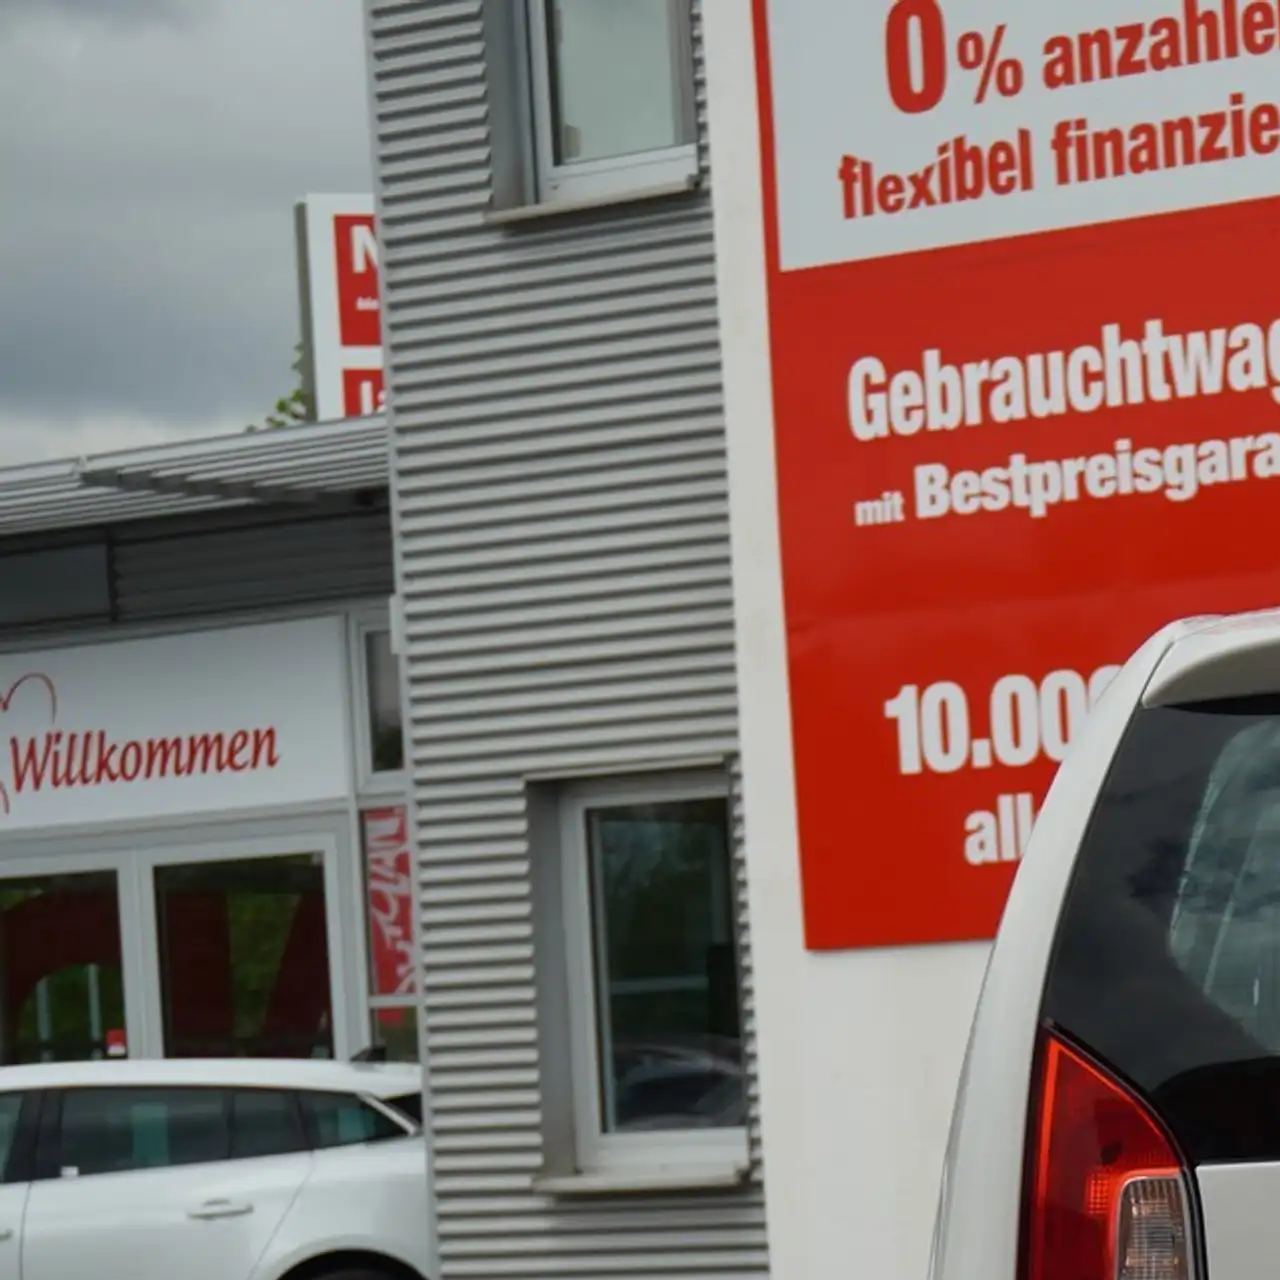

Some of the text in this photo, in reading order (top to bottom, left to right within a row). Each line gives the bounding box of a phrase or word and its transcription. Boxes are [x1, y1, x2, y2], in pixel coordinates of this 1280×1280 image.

[838, 127, 1034, 220] flexibel
[854, 491, 905, 527] mit
[884, 664, 1124, 775] 10.00
[9, 726, 279, 793] Willkommen
[963, 793, 1040, 865] all
